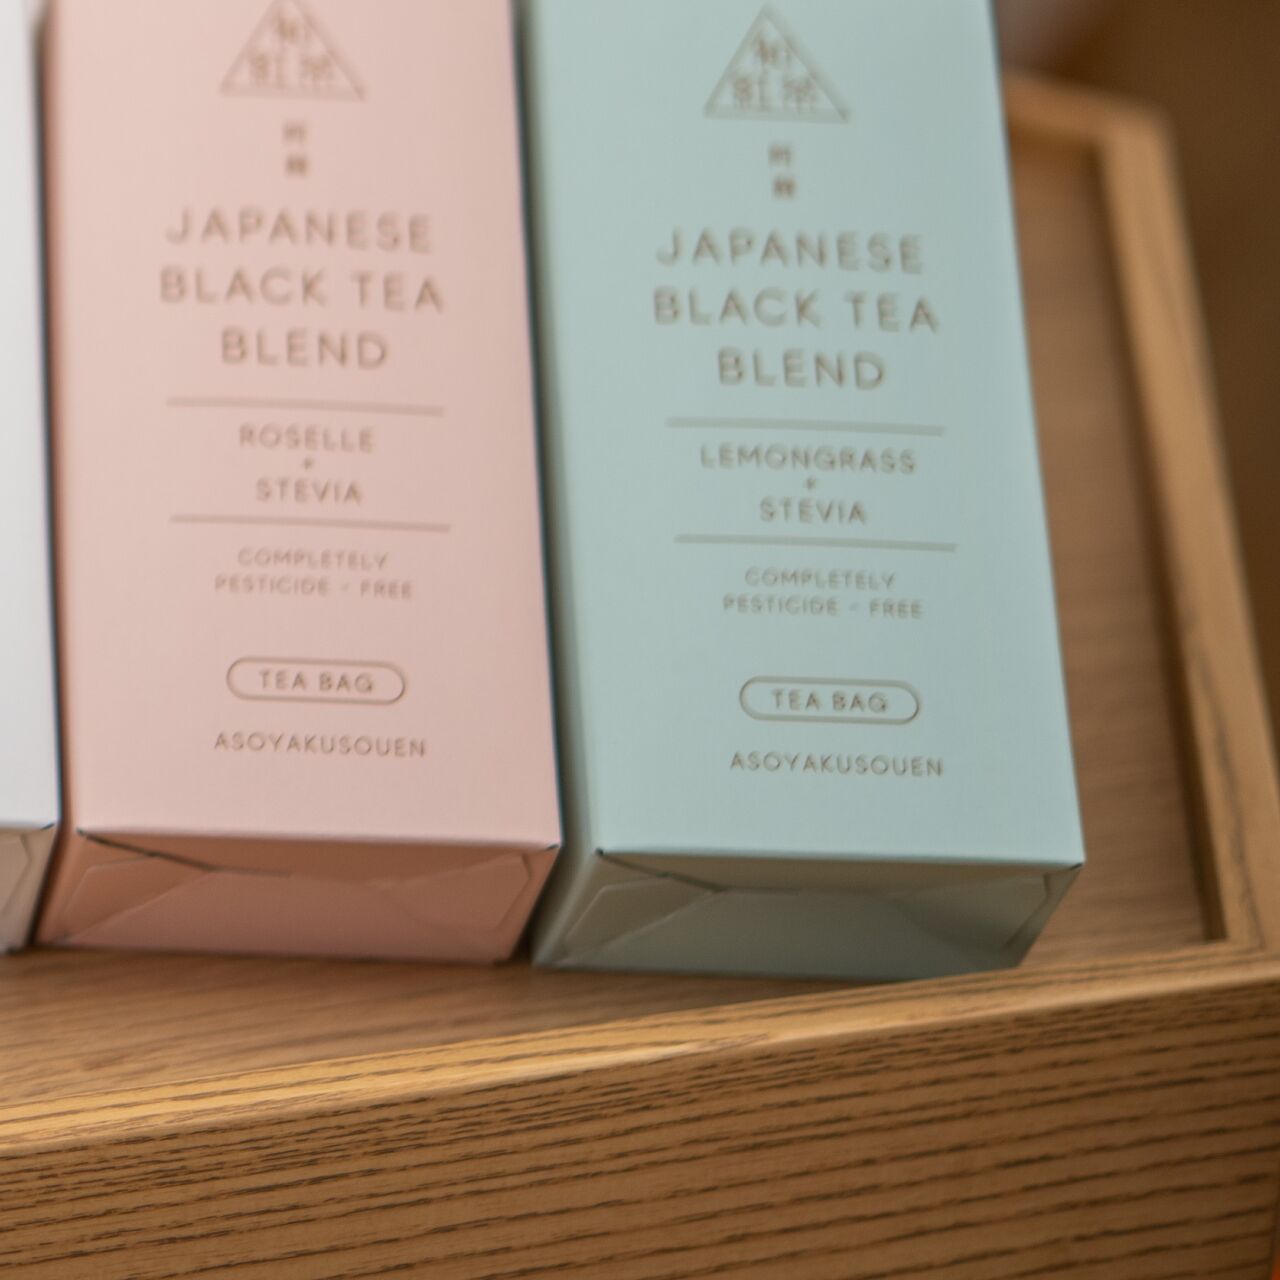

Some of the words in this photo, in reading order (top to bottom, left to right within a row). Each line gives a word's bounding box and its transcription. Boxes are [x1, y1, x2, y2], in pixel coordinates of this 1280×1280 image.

[166, 208, 434, 254] JAPANESE
[655, 227, 925, 275] JAPANESE
[159, 265, 328, 307] BLACK
[351, 271, 445, 314] TEA
[652, 286, 822, 329] BLACK
[845, 291, 941, 335] TEA
[220, 327, 390, 371] BLEND
[716, 346, 887, 391] BLEND
[238, 424, 376, 454] ROSELLE
[699, 443, 918, 475] LEMONGRASS
[255, 476, 363, 506] STEVIA
[758, 496, 868, 524] STEVIA
[237, 547, 390, 571] COMPLETELY
[214, 573, 330, 597] PESTICIDE
[359, 577, 414, 601] FREE
[744, 566, 897, 590] COMPLETELY
[722, 594, 840, 616] PESTICIDE
[868, 598, 924, 620] FREE
[258, 668, 308, 692] TEA
[318, 670, 376, 695] BAG
[769, 688, 821, 712] TEA
[831, 690, 889, 714] BAG
[214, 731, 427, 759] ASOYAKUSOUEN
[729, 751, 944, 778] ASOYAKUSOUEN
